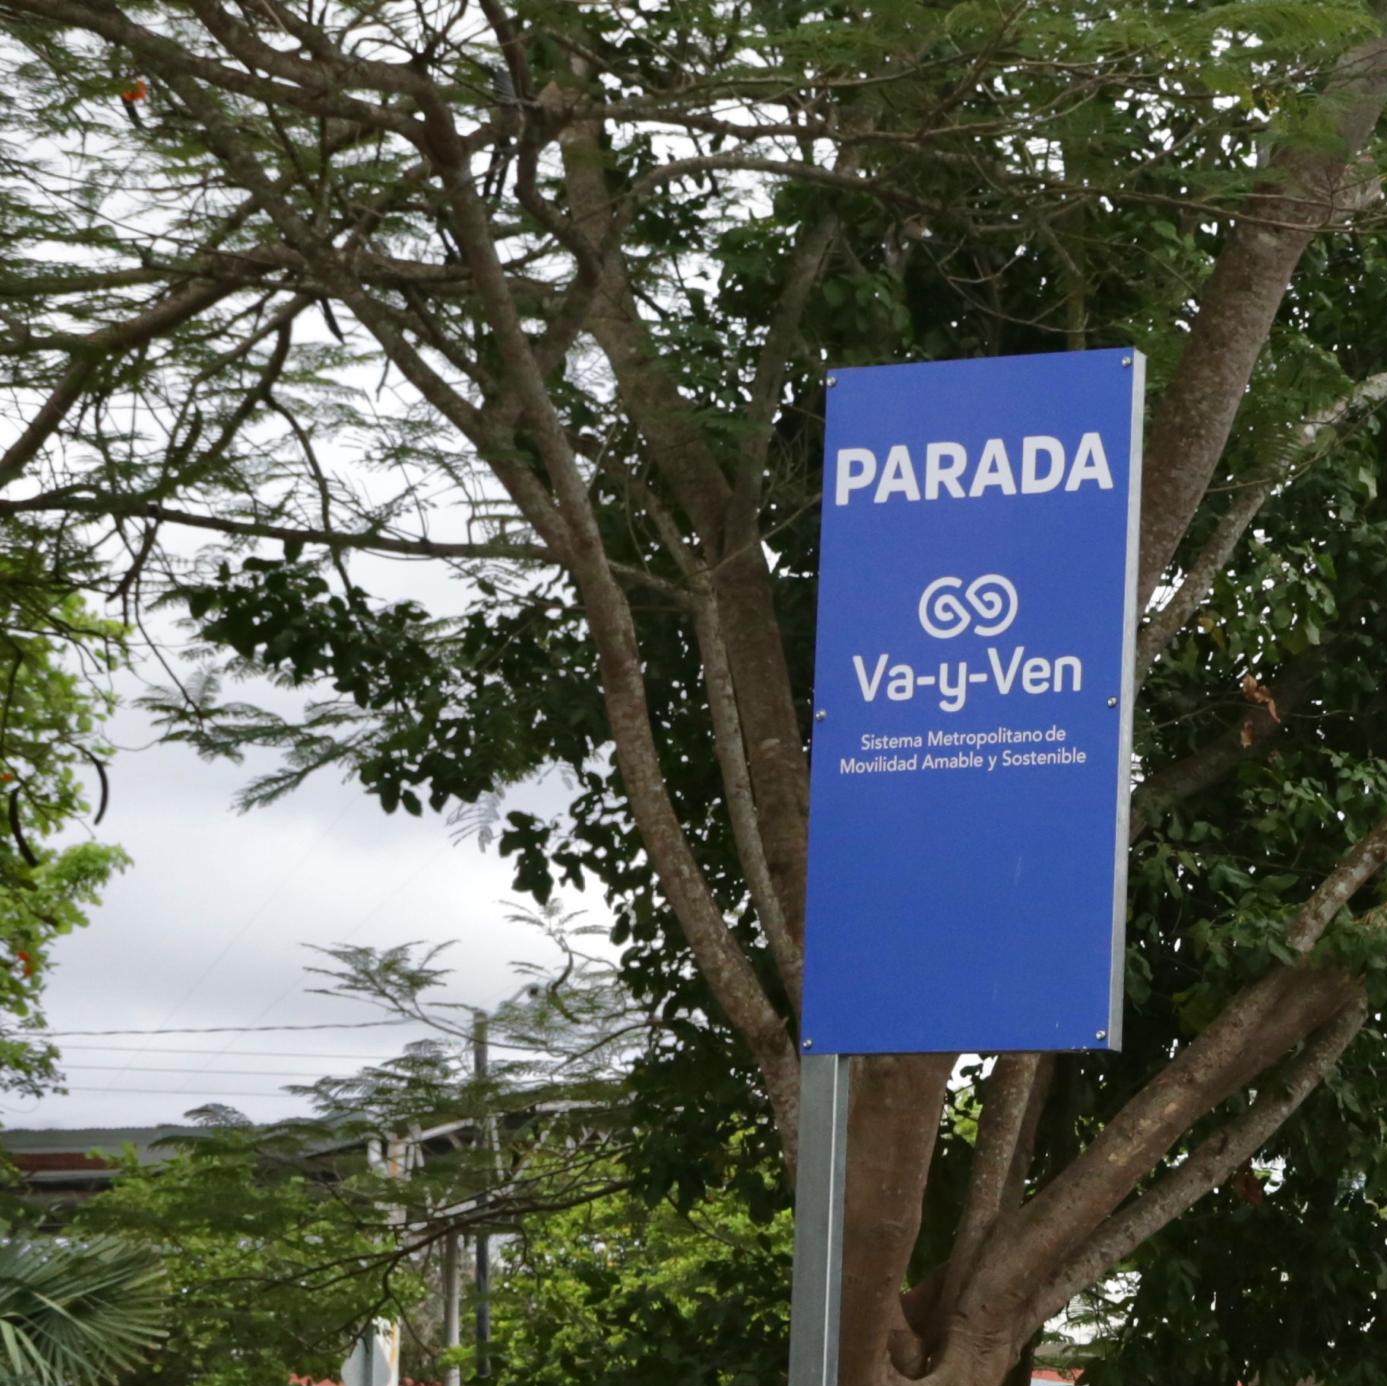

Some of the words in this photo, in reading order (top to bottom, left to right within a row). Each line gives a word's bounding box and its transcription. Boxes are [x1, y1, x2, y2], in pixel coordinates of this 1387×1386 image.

[836, 432, 1114, 506] PARADA
[852, 646, 1082, 712] Va-y-Ven
[840, 754, 917, 774] Movilidad
[922, 751, 983, 770] Amable
[988, 753, 997, 772] y
[1002, 747, 1087, 767] Sostenible
[861, 733, 922, 751] Sistema
[927, 727, 1043, 749] Metropolitano
[1045, 724, 1066, 742] de
